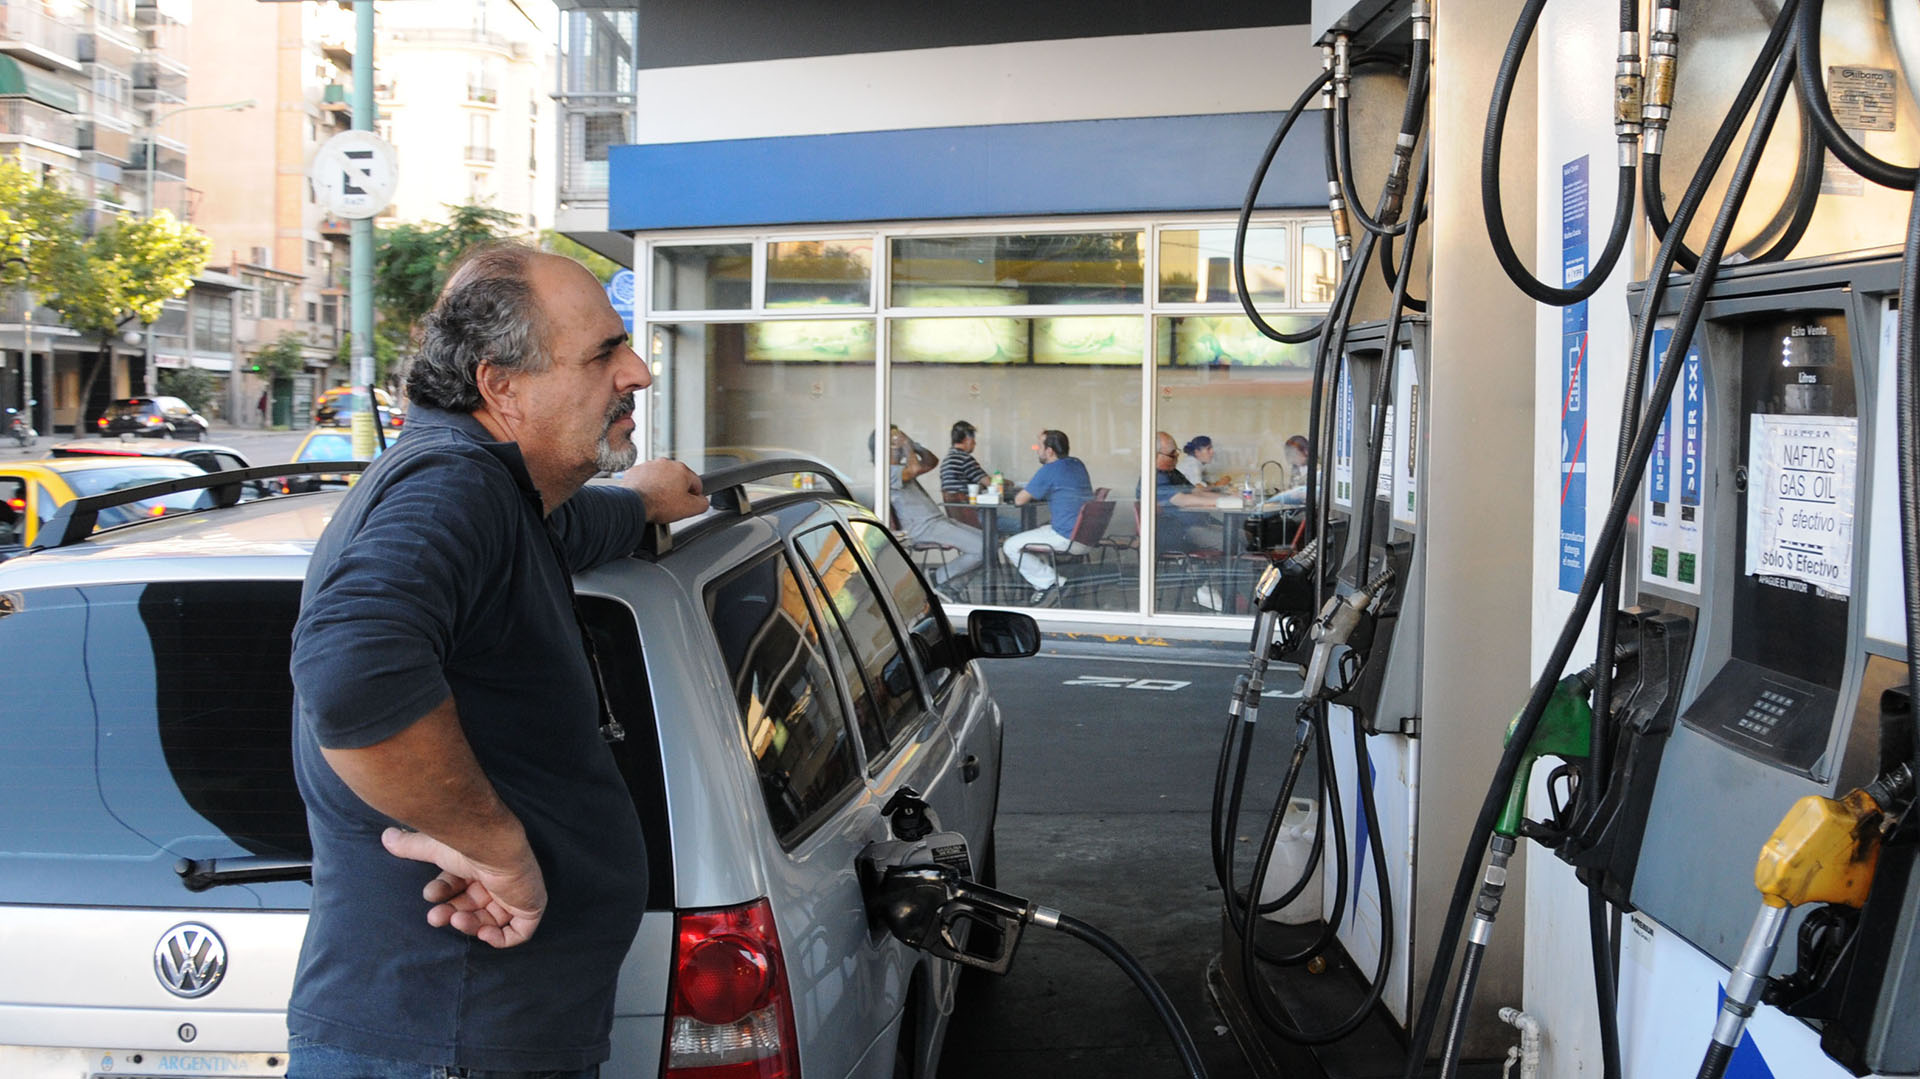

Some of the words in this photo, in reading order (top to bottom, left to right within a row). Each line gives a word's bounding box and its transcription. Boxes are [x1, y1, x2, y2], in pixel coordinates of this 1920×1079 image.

[1791, 325, 1806, 337] Esta
[1806, 325, 1828, 336] Venta
[1688, 354, 1699, 402] XXI
[1686, 409, 1697, 491] SUPER
[1783, 444, 1836, 470] NAFTAS
[1779, 473, 1806, 497] GAS
[1813, 475, 1836, 499] OIL
[1792, 508, 1835, 532] efectivo
[1796, 553, 1840, 579] Efectivo
[1787, 580, 1808, 593] MOTOR
[158, 1055, 249, 1072] ARGENTINA
